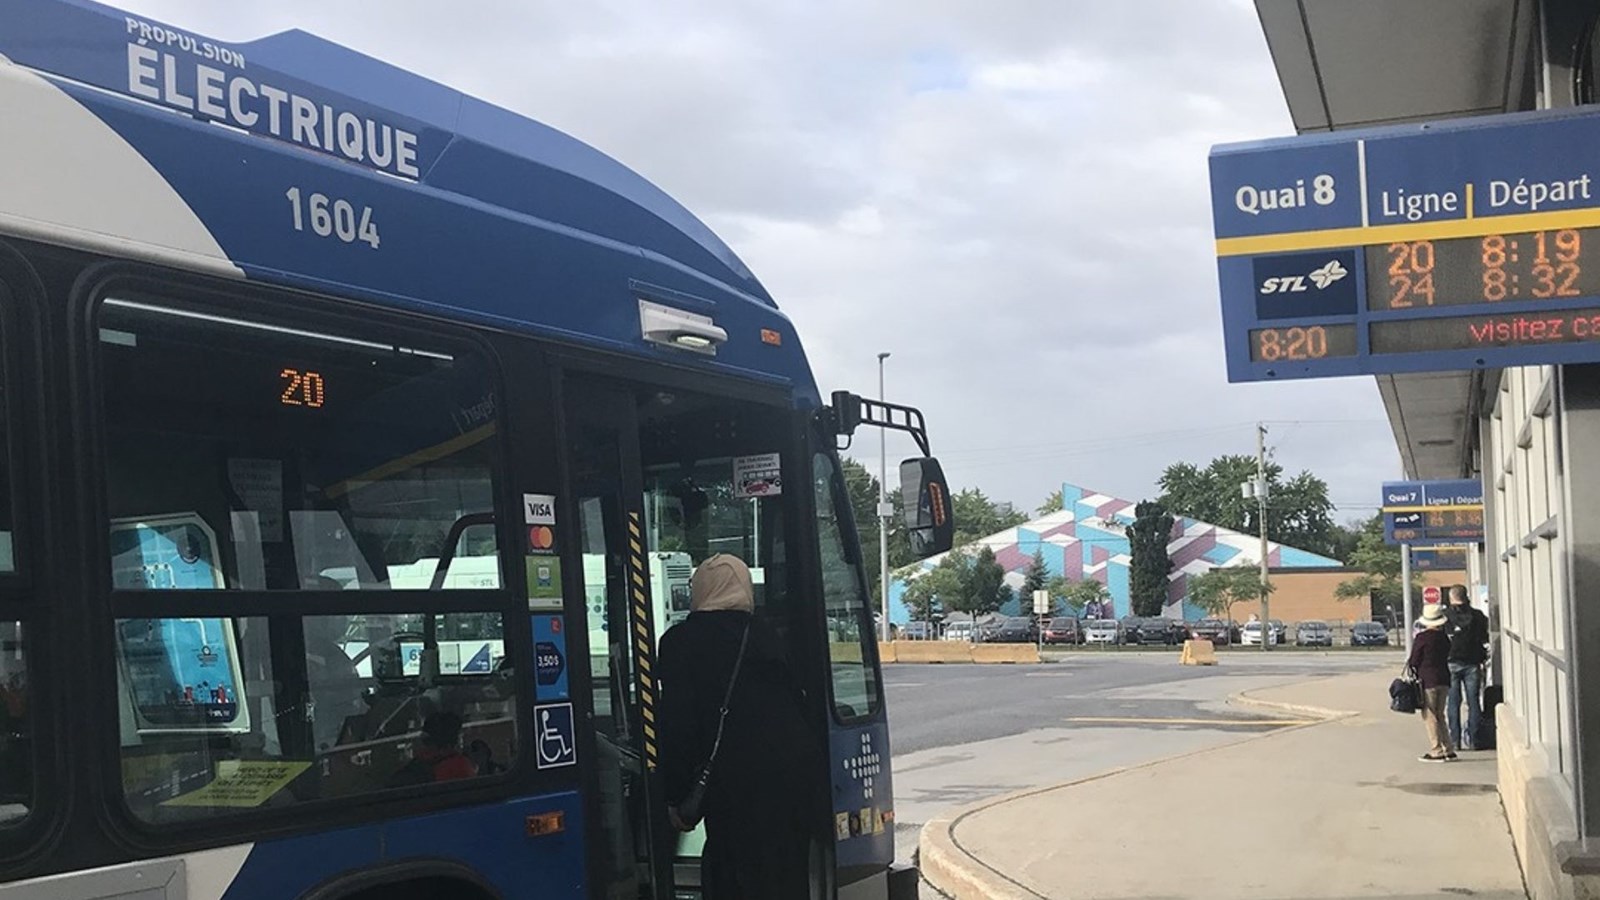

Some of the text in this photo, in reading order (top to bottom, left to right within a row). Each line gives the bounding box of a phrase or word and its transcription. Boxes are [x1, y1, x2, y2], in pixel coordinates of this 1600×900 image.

[125, 17, 246, 69] PROPULSION
[127, 38, 420, 178] ÉLECTRIQUE
[1235, 174, 1336, 214] Quai 8
[1382, 189, 1458, 221] Ligne
[1490, 174, 1591, 210] Départ
[285, 186, 381, 249] 1604
[1387, 240, 1435, 277] 20
[1260, 275, 1307, 294] STL
[1389, 272, 1436, 308] 24
[1259, 325, 1328, 361] 8:20
[1470, 317, 1564, 342] visitez
[280, 368, 324, 408] 20
[528, 503, 552, 518] VISA
[1388, 491, 1416, 503] Quai 7
